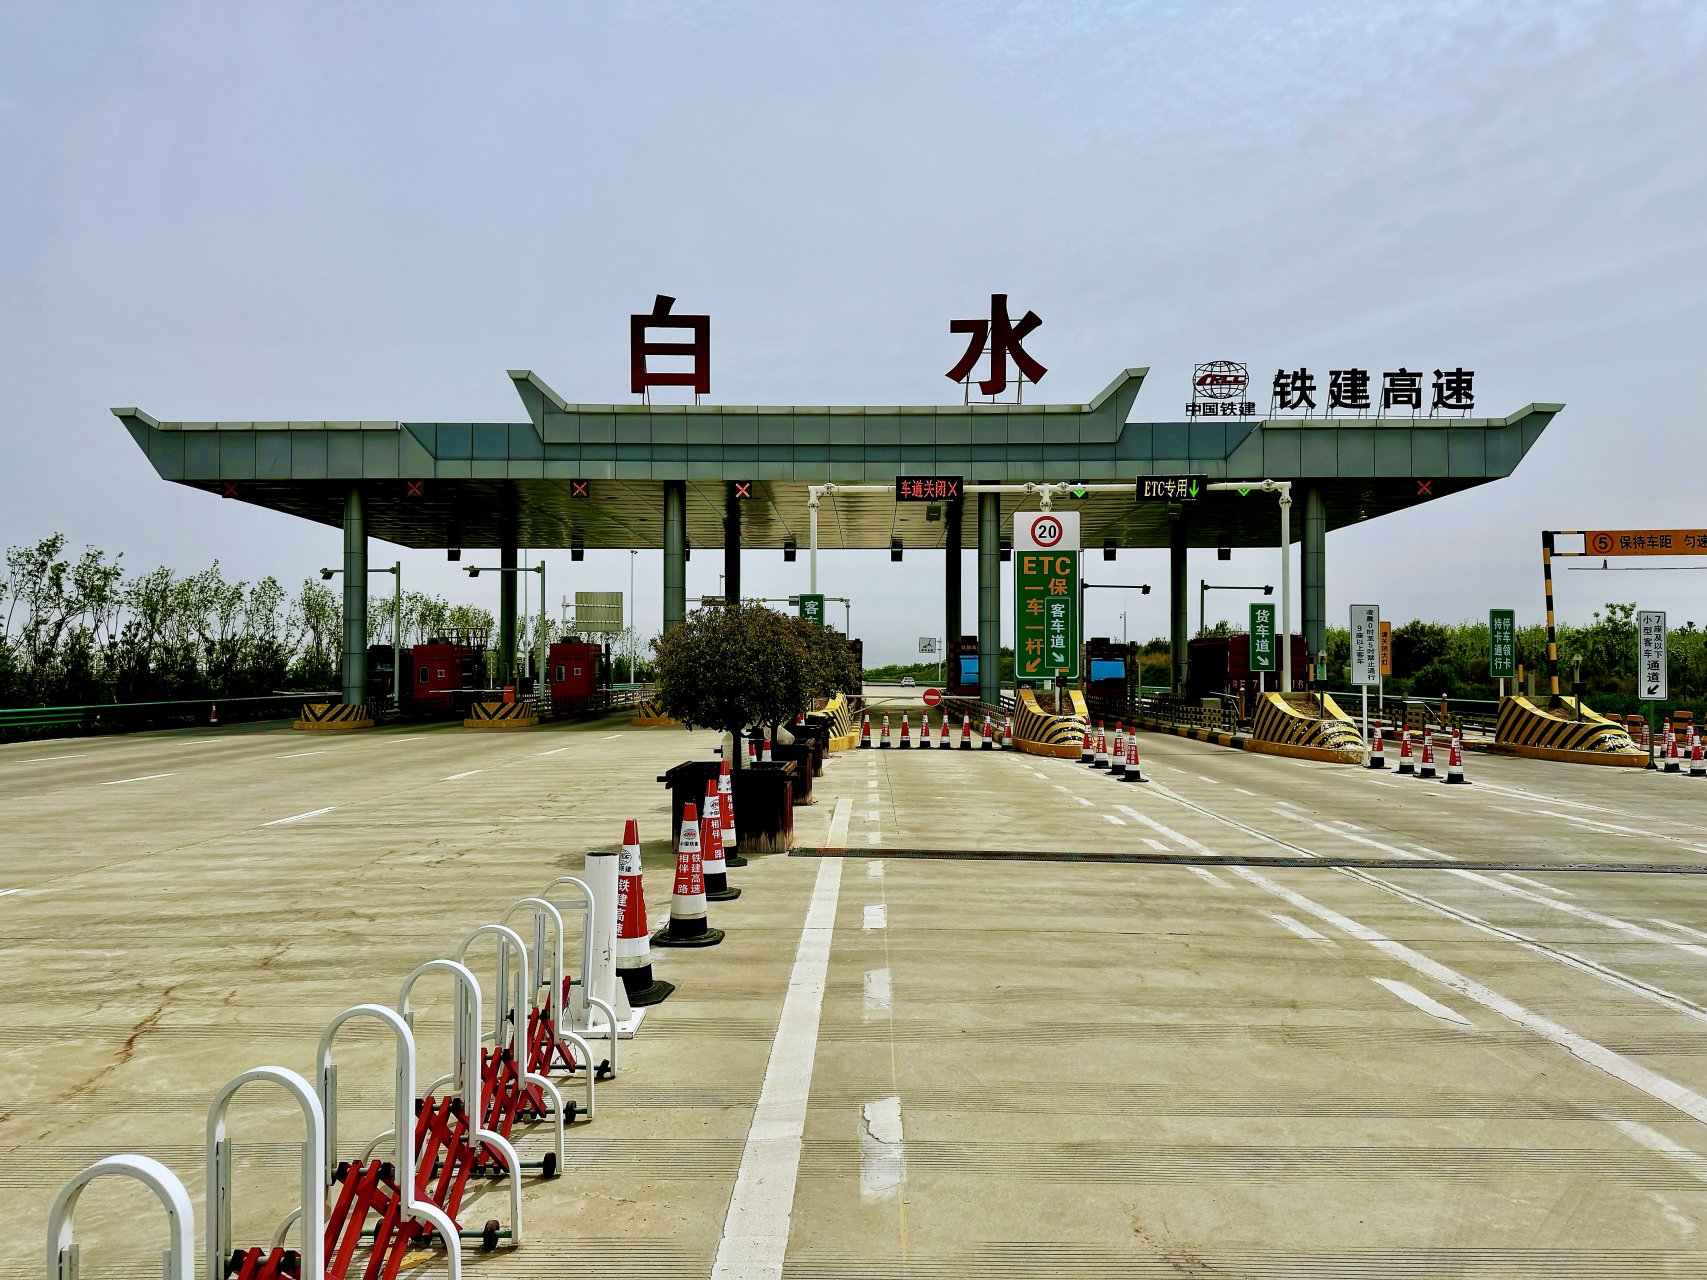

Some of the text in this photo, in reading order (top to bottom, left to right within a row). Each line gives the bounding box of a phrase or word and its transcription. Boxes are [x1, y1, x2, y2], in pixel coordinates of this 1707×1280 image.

[1185, 402, 1256, 417] 中国铁建
[1273, 367, 1475, 410] 铁建高速
[1038, 525, 1057, 539] 20
[1598, 536, 1608, 550] 5
[1619, 535, 1673, 550] 保持车距
[1023, 556, 1071, 575] ETC
[1024, 585, 1045, 655] 一车一杆
[1050, 603, 1066, 649] 客车道
[1255, 609, 1271, 653] 货车道
[1643, 614, 1653, 659] 小型客车
[1653, 615, 1663, 659] 7座及以下
[1493, 617, 1503, 670] 持卡通行
[1502, 617, 1512, 670] 停车领卡
[1646, 660, 1661, 683] 通道
[677, 853, 689, 894] 相伴一路
[690, 853, 701, 894] 铁建高速
